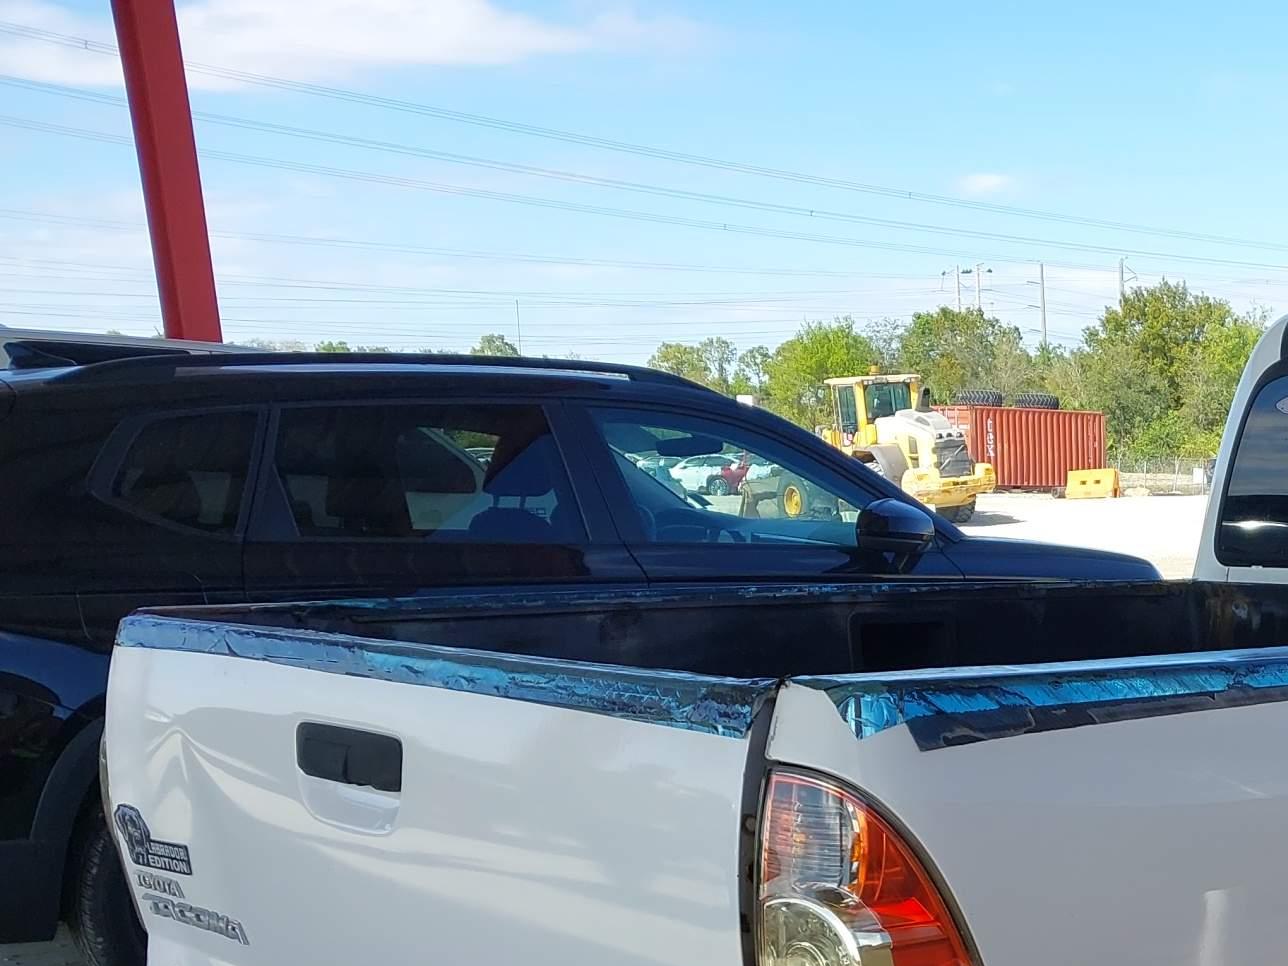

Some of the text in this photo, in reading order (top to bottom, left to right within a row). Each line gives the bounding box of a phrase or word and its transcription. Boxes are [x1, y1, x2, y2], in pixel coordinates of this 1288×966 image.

[149, 854, 191, 874] EDITION
[135, 869, 186, 898] TOYOTA
[141, 892, 249, 944] TACOMA
